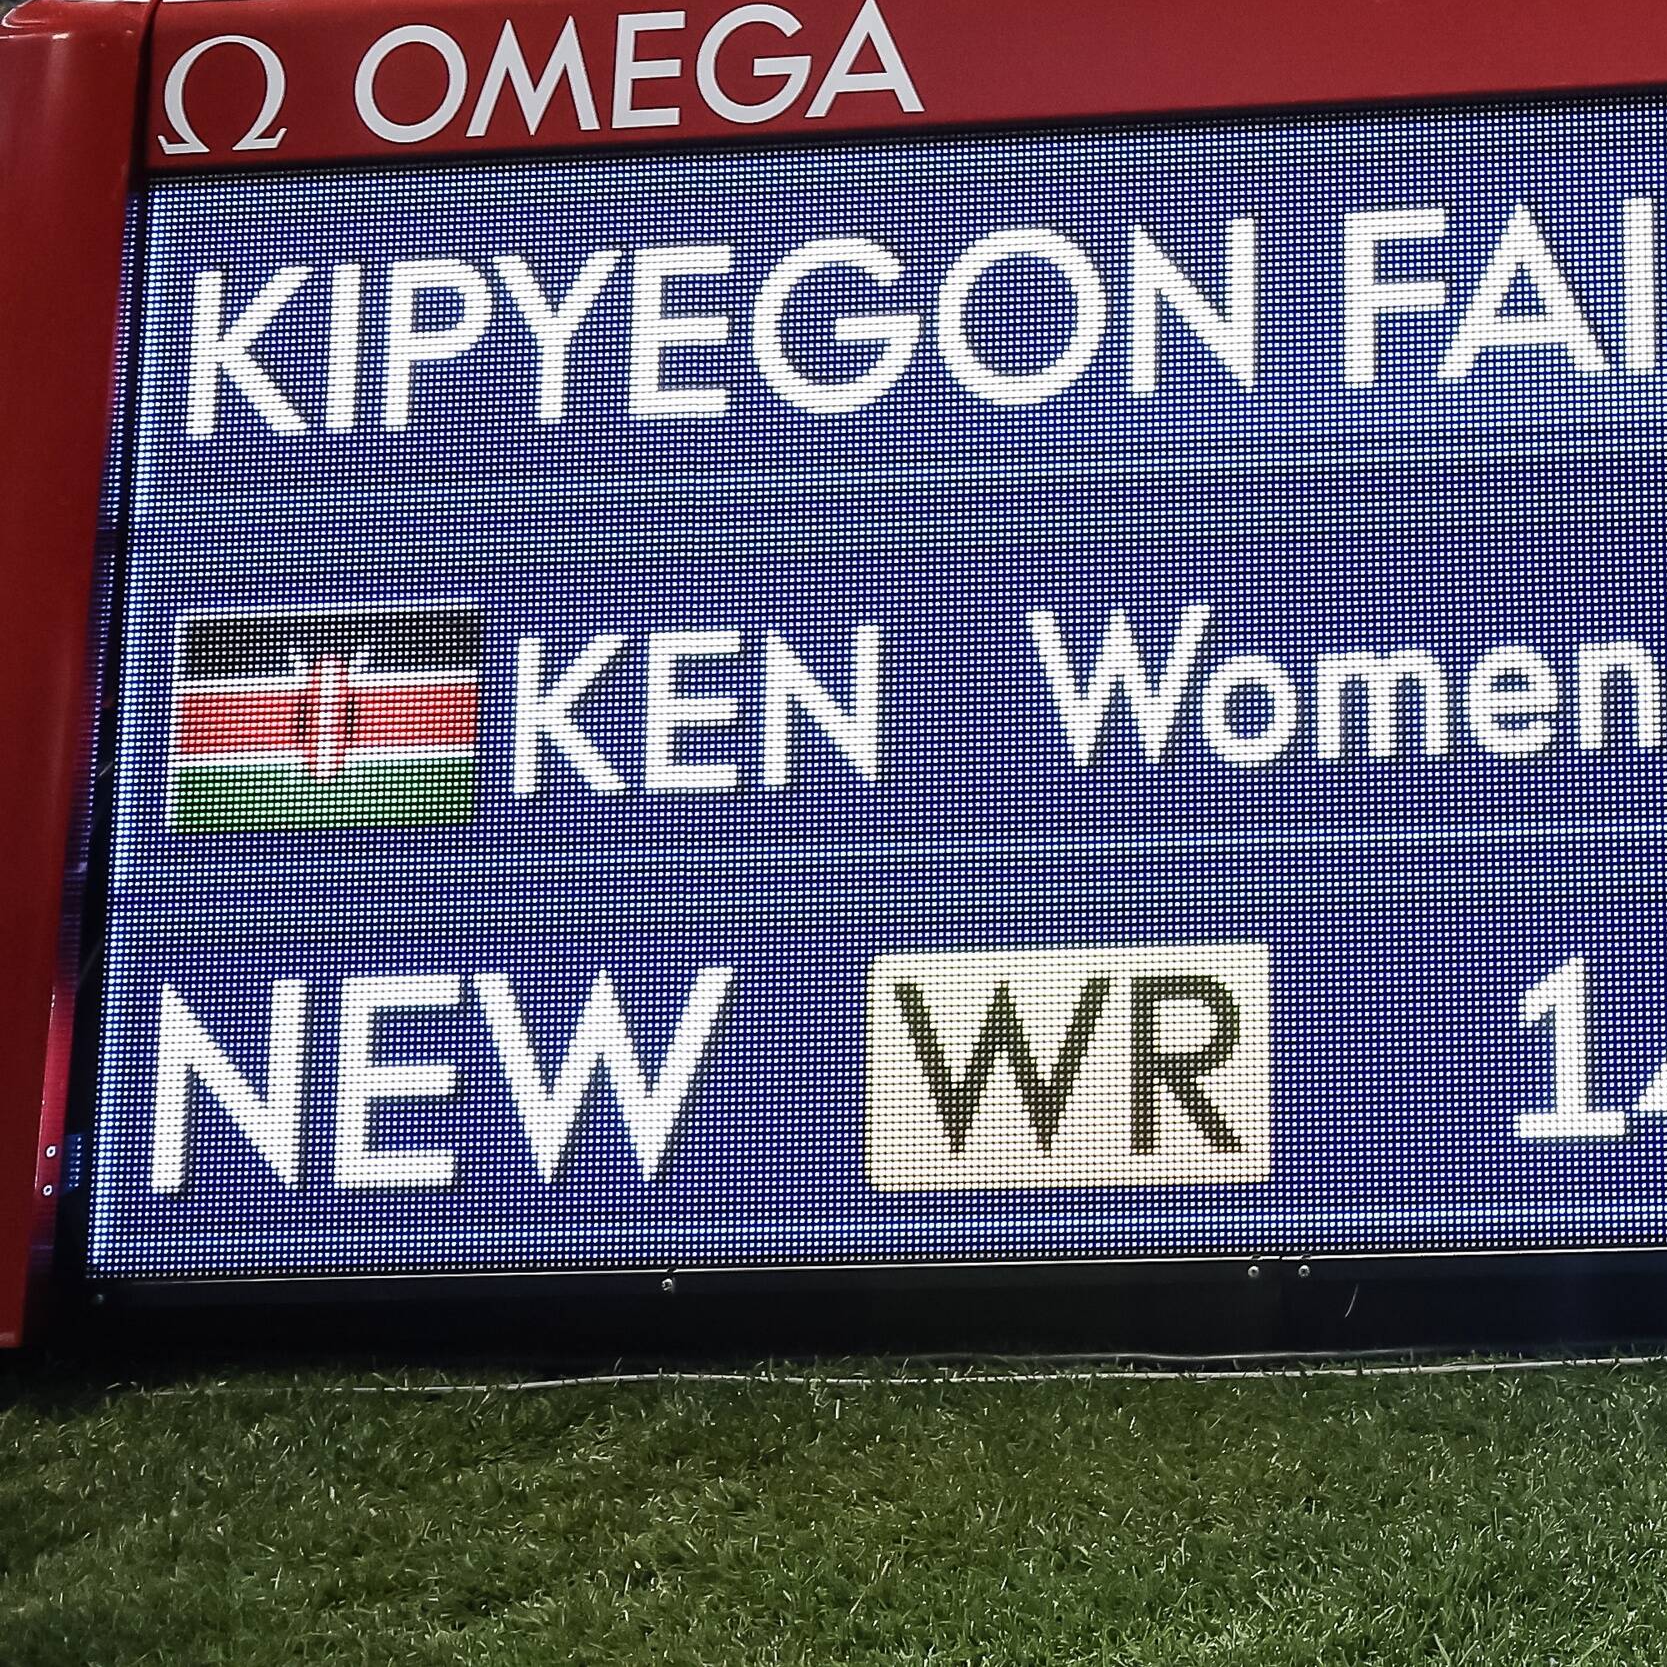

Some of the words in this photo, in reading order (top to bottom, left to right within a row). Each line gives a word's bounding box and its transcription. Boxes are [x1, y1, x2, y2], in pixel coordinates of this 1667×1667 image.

[186, 217, 1256, 440] KIPYEGON
[513, 625, 882, 798] KEN
[149, 965, 733, 1194] NEW
[893, 976, 1241, 1156] WR
